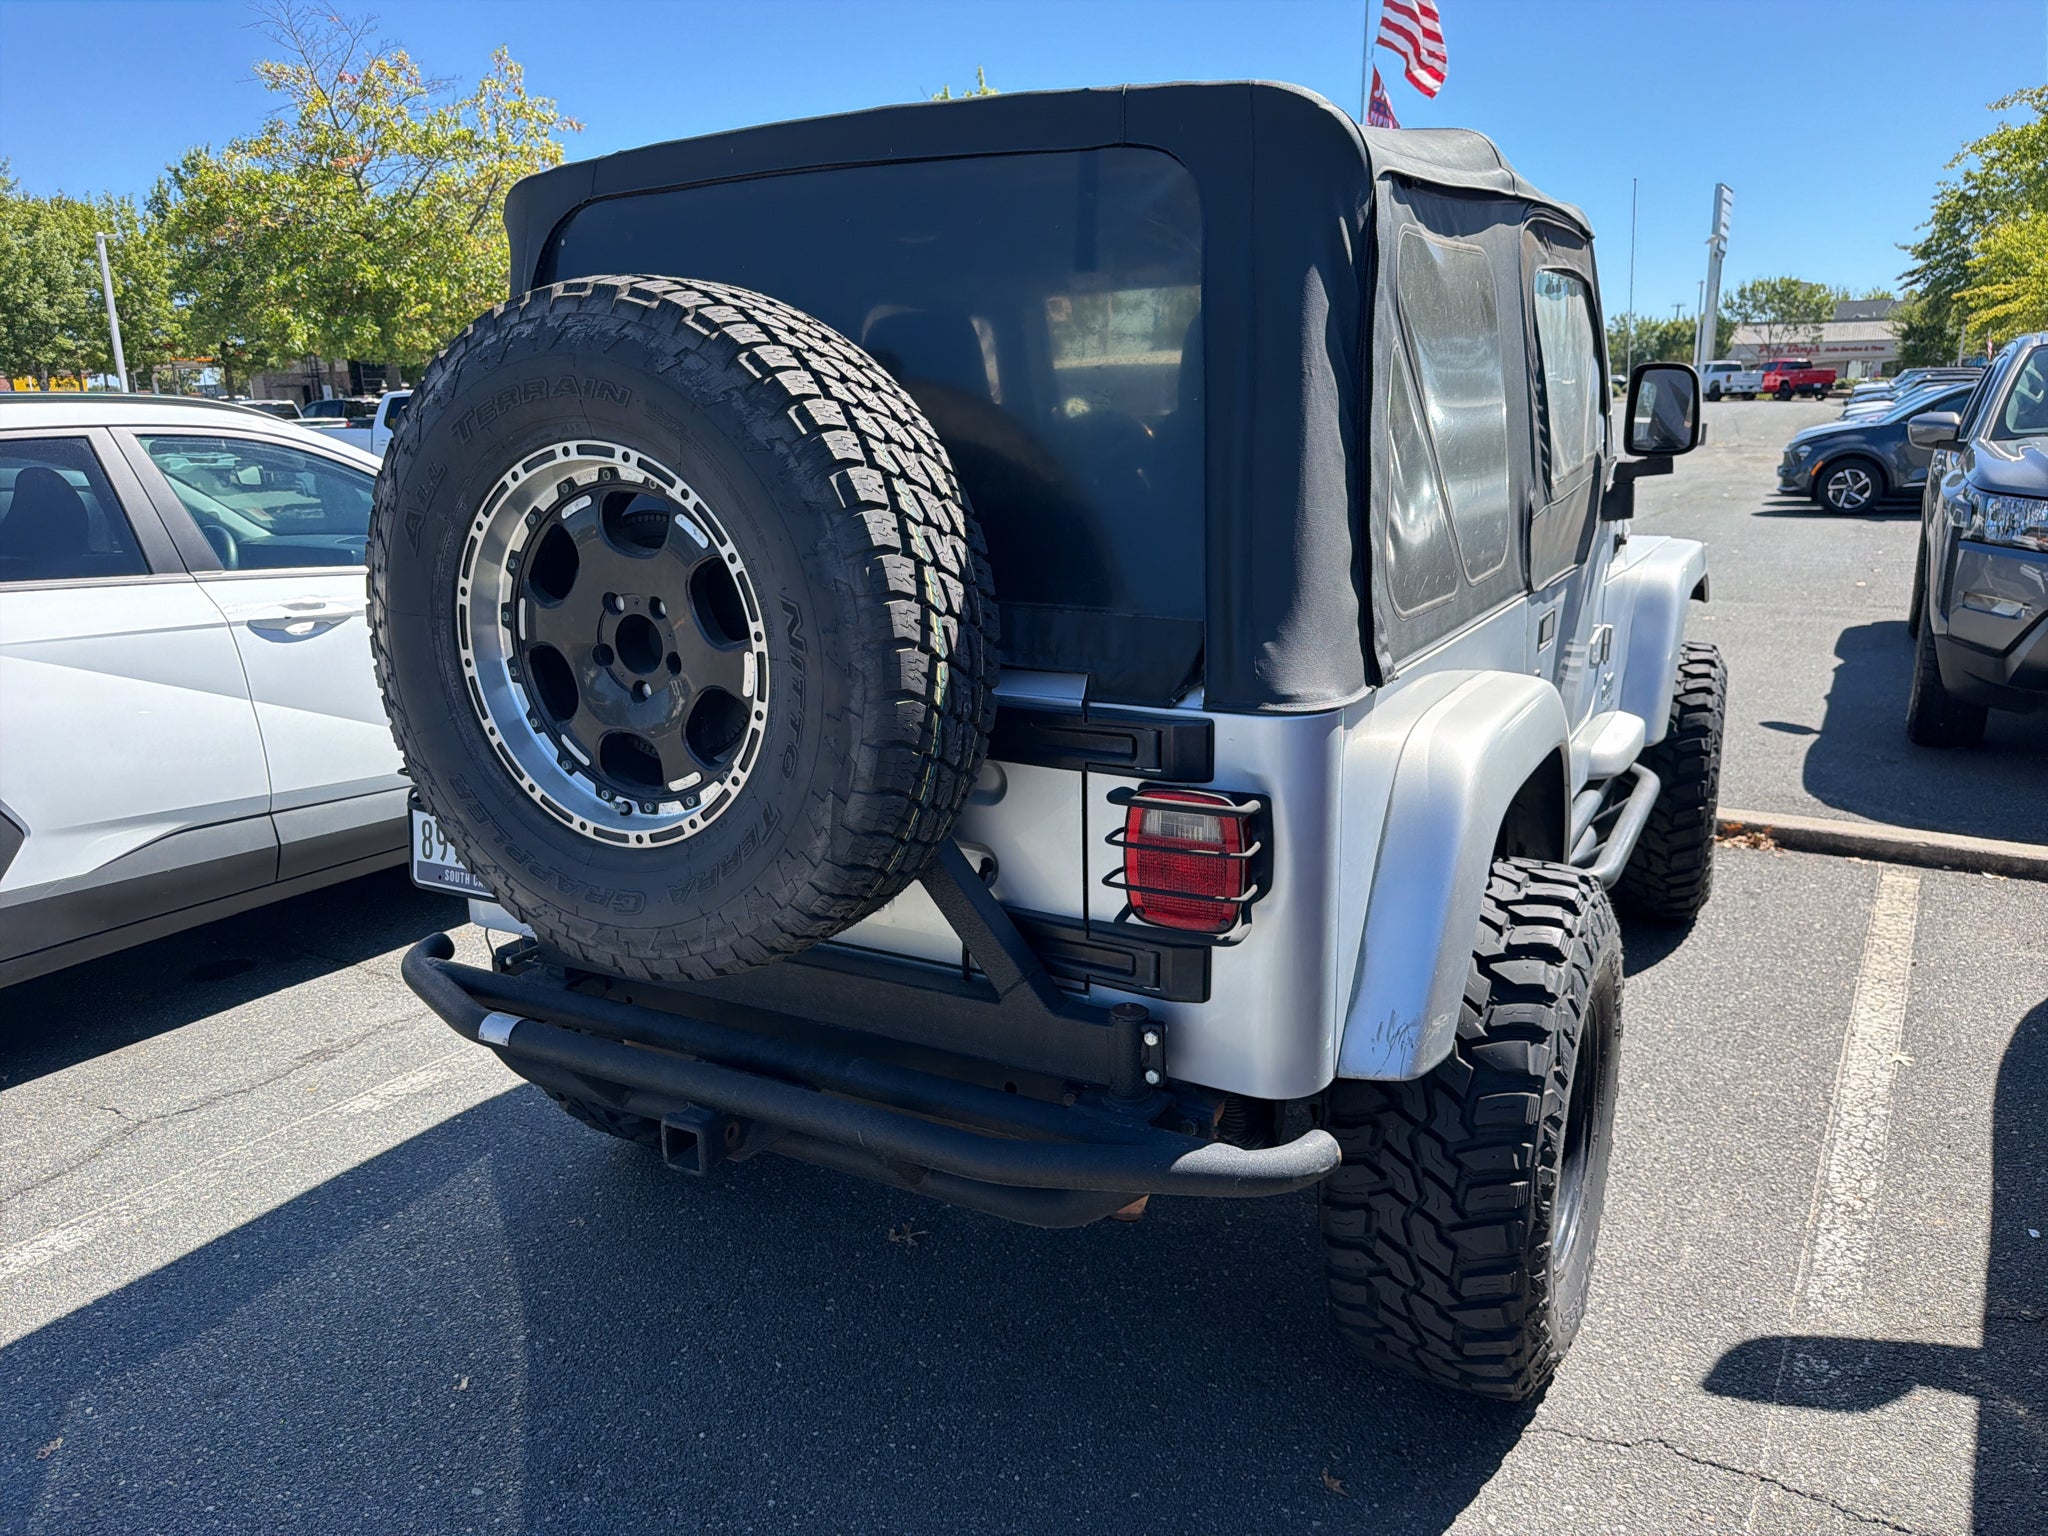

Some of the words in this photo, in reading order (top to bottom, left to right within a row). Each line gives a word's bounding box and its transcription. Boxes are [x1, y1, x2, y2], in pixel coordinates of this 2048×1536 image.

[404, 463, 448, 553] ALL
[451, 376, 632, 445] TERRAIN
[780, 595, 808, 781] NITTO
[421, 819, 461, 864] 89
[444, 869, 470, 885] SOUTH
[447, 771, 647, 915] GRAPPLER
[669, 803, 782, 906] TERRA
